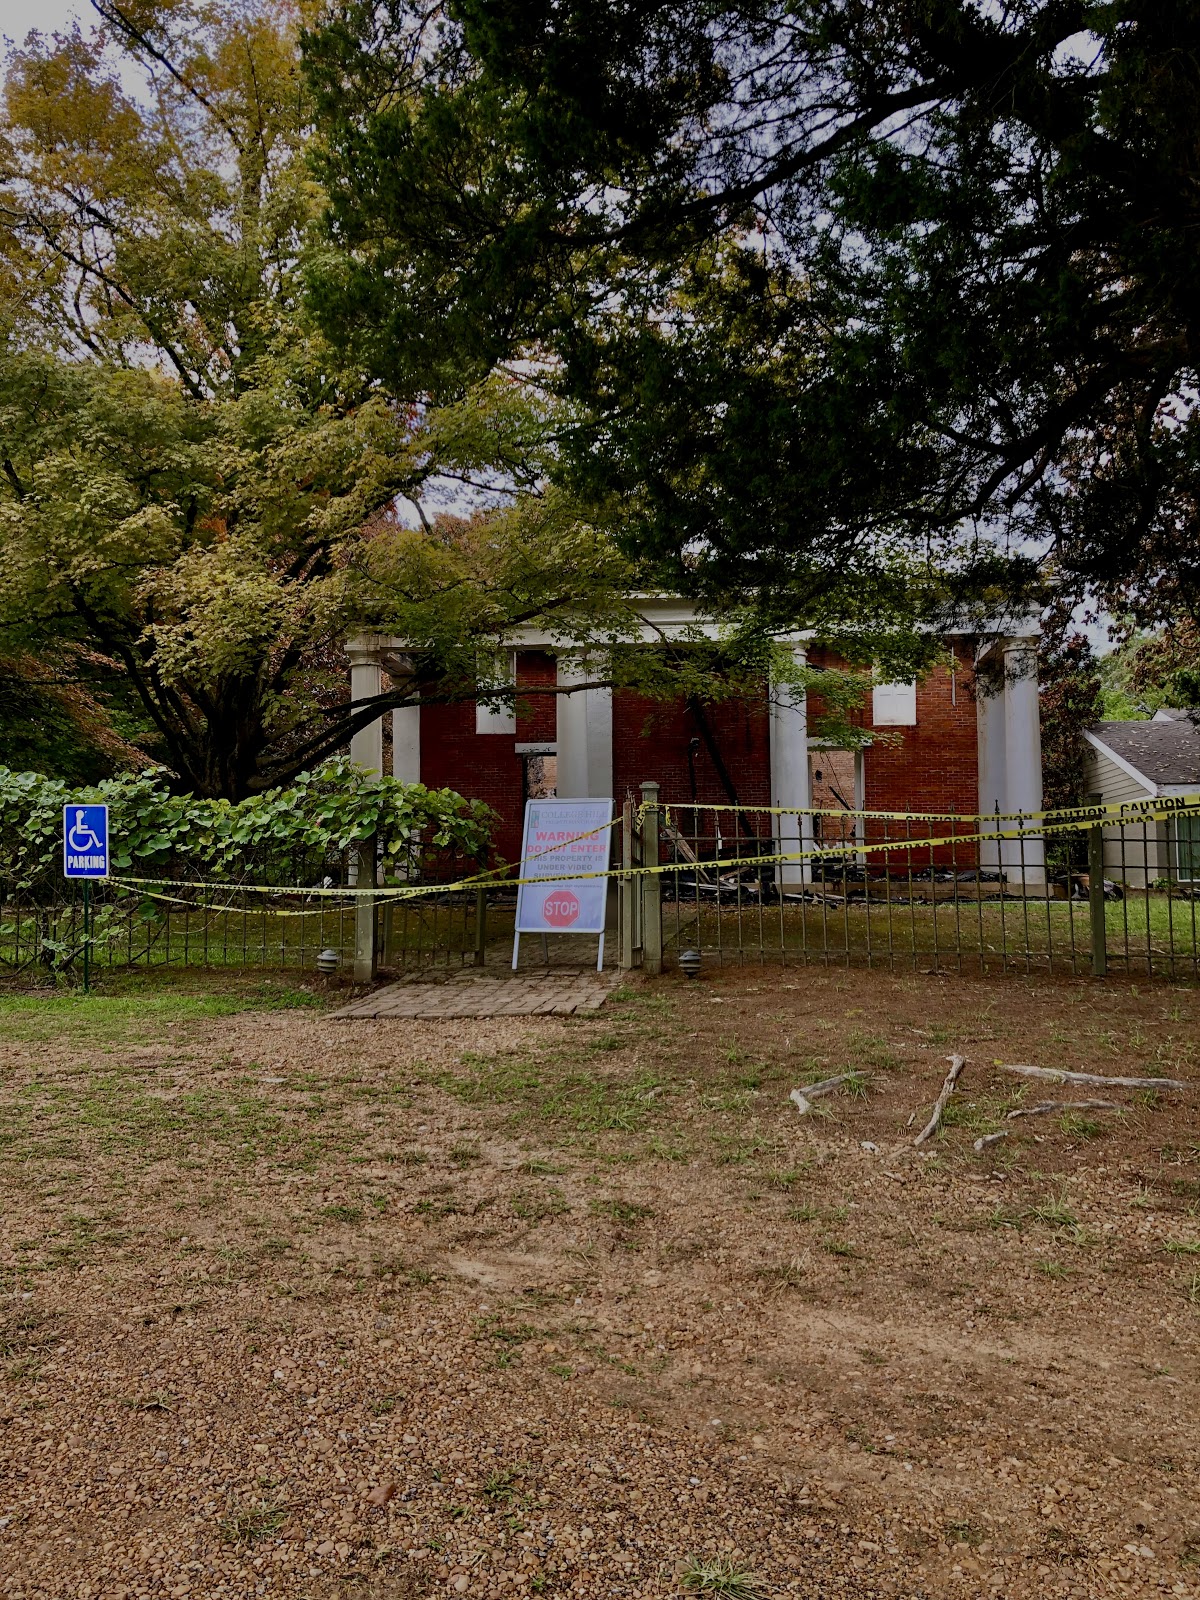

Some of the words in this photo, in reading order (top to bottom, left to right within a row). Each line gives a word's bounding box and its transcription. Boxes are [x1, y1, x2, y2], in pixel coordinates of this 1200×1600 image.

[1045, 807, 1107, 819] CAUTION
[1121, 797, 1186, 811] CAUTION
[536, 831, 599, 841] WARNING
[527, 844, 542, 853] DO
[545, 844, 567, 853] NOT
[570, 844, 607, 853] ENTER
[67, 855, 106, 869] PARKING
[545, 901, 578, 916] STOP
